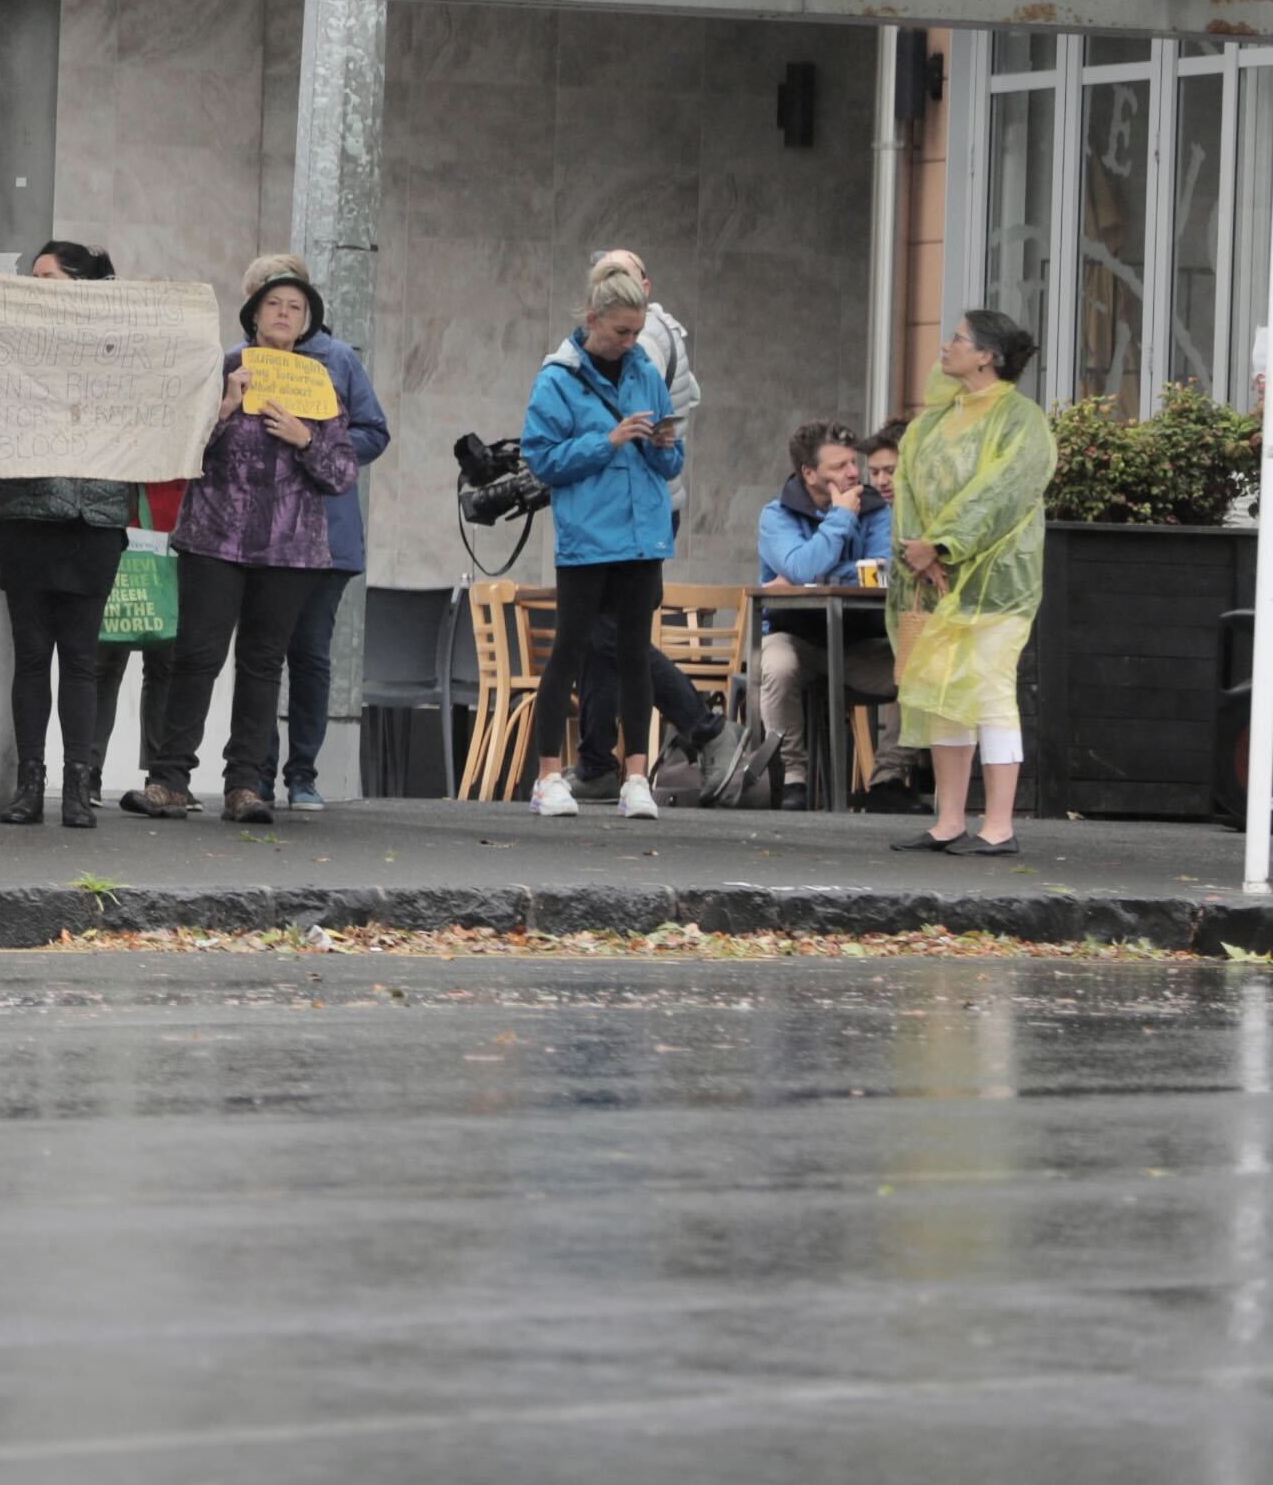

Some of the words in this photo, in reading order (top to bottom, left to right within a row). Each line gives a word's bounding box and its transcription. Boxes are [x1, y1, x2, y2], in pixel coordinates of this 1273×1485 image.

[67, 372, 135, 400] RIGHT
[160, 374, 183, 399] TO
[6, 404, 47, 429] FOR
[107, 588, 147, 602] REEN
[104, 602, 121, 617] IN
[123, 602, 156, 617] THE
[104, 617, 165, 633] WORLD
